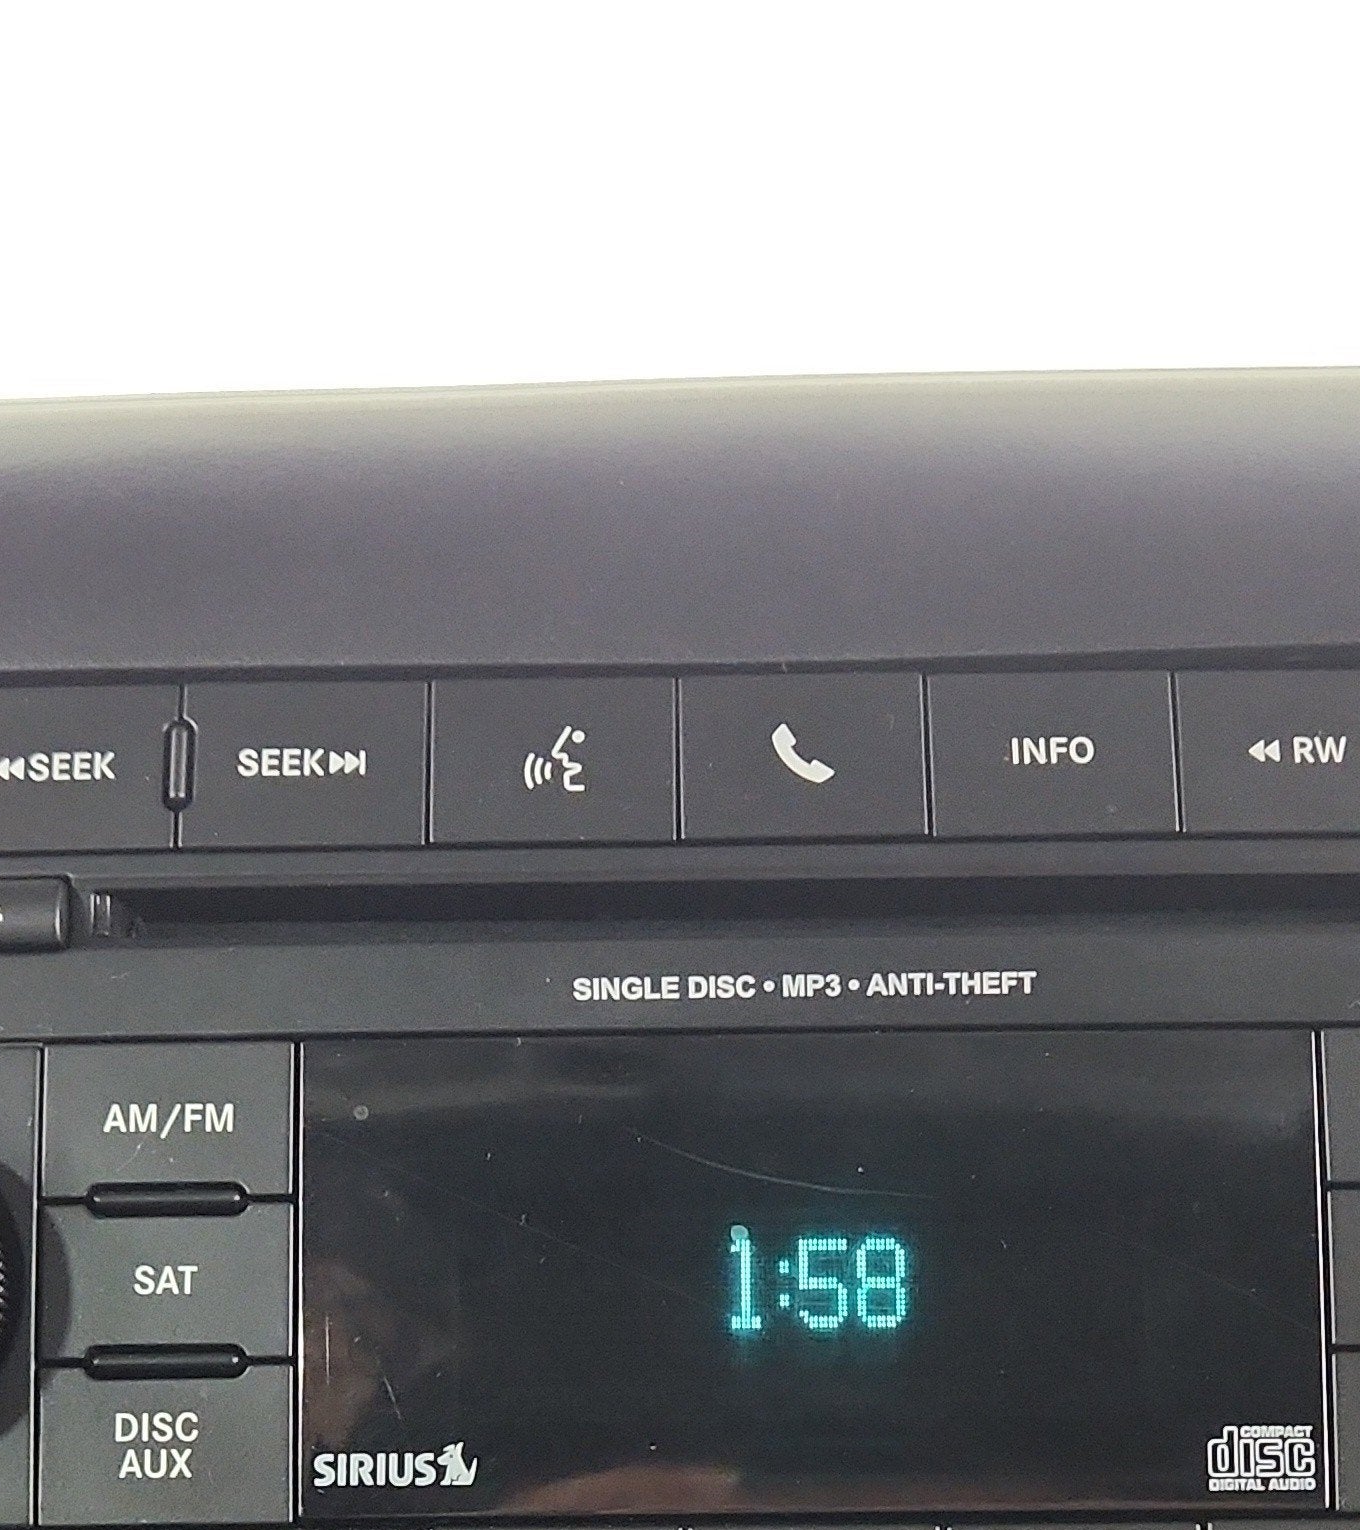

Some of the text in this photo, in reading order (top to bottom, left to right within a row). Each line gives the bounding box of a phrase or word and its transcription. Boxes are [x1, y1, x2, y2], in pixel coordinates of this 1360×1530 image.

[237, 747, 325, 777] SEEK
[1011, 736, 1095, 765] INFO
[1292, 735, 1347, 764] RW
[27, 751, 116, 782] SEEK
[572, 970, 1038, 1001] SINGLE DISC MP3 ANTI-THEFT
[102, 1102, 235, 1140] AM/FM
[133, 1265, 199, 1295] SAT
[730, 1228, 907, 1331] 1:58
[114, 1411, 199, 1443] DISC
[1240, 1425, 1313, 1438] COMPACT
[118, 1448, 193, 1479] AUX
[313, 1452, 437, 1487] SIRIUS
[1208, 1477, 1317, 1491] DIGITAL AUDIO
